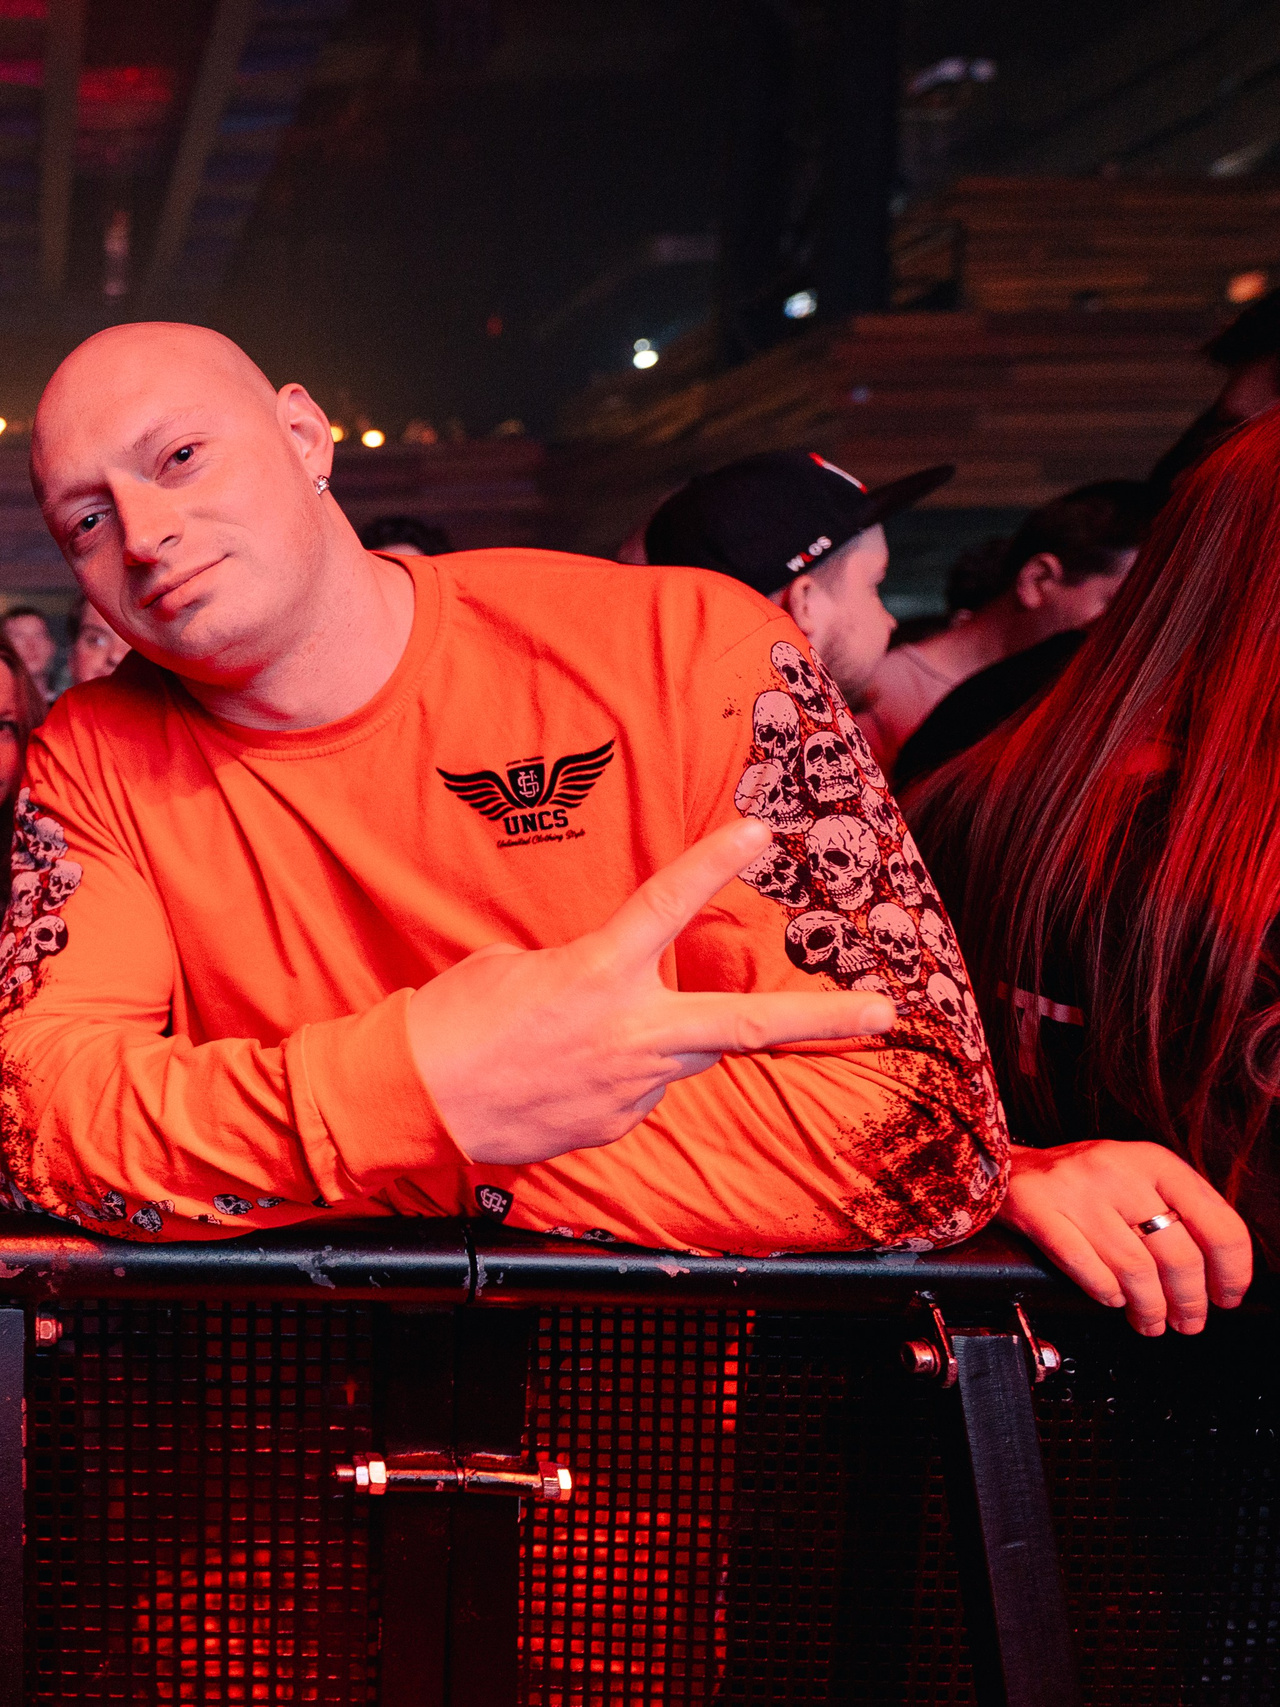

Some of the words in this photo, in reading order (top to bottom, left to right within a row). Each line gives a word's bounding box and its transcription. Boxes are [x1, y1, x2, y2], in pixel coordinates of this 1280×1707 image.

[503, 809, 568, 835] UNCS
[497, 837, 531, 848] Unlimited
[532, 834, 563, 844] Clothing
[565, 829, 585, 839] Style
